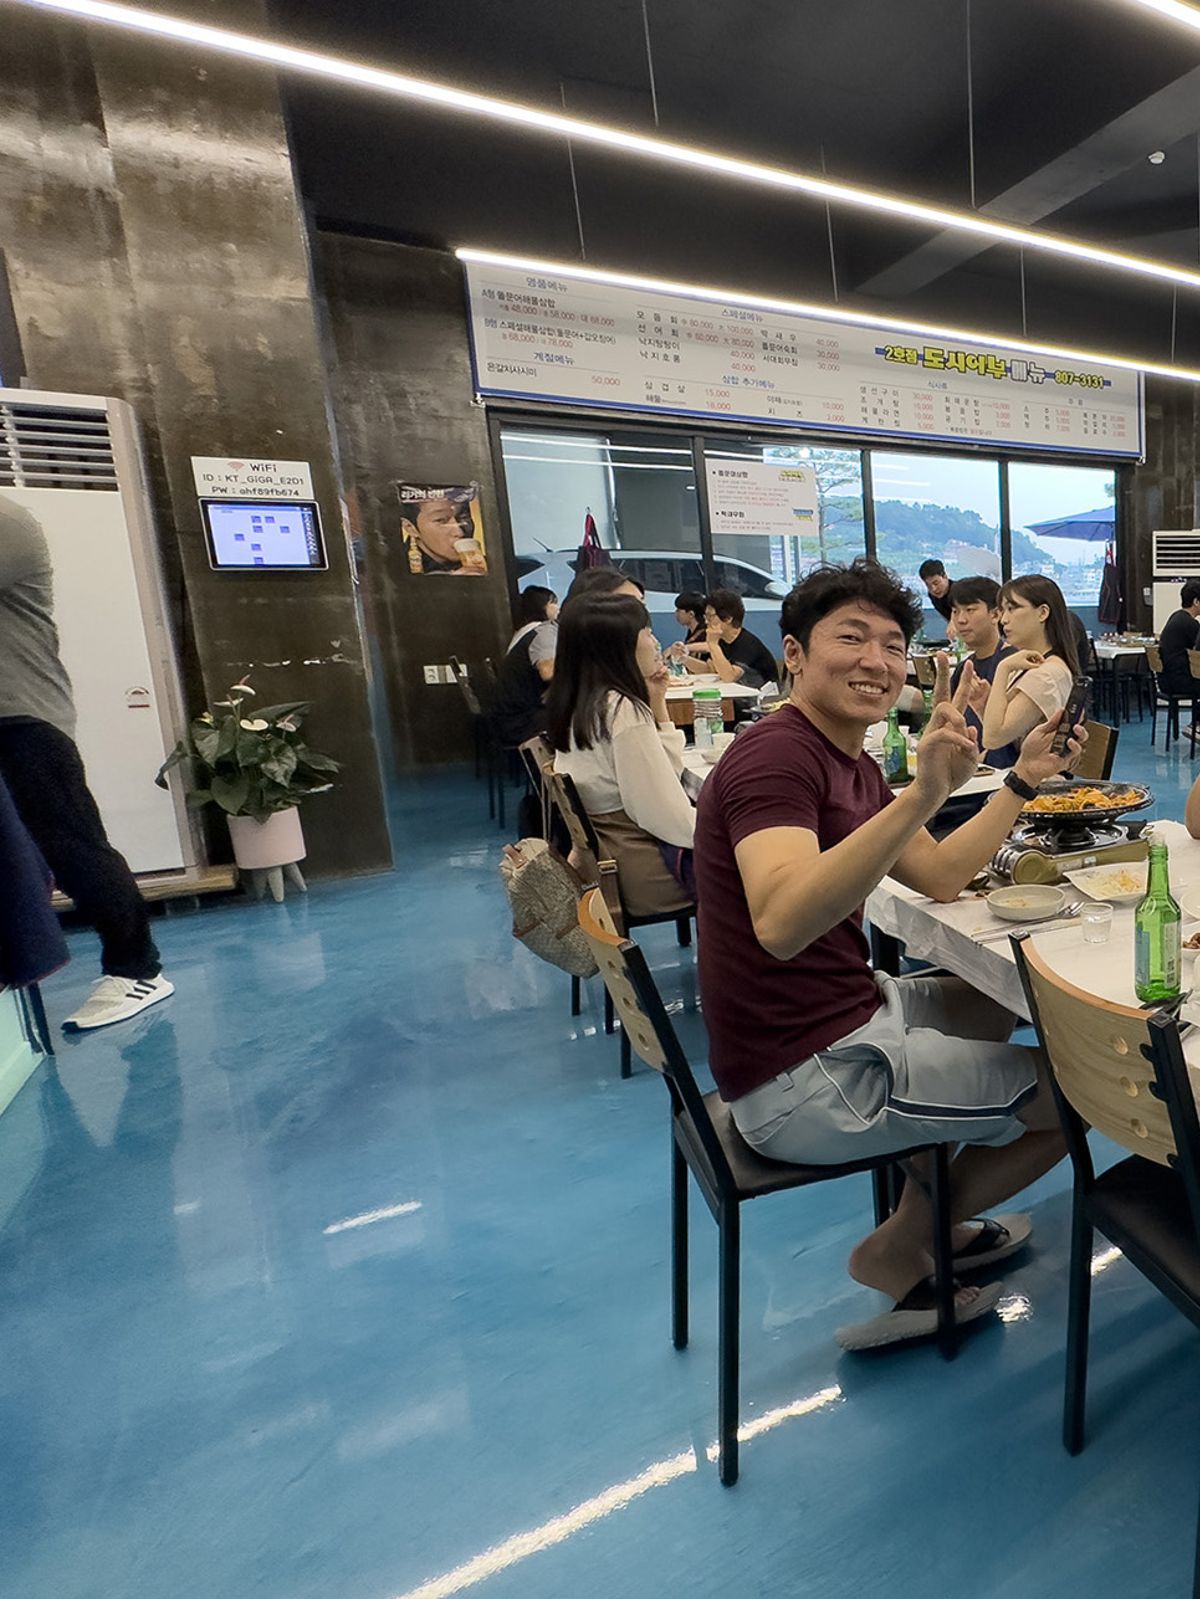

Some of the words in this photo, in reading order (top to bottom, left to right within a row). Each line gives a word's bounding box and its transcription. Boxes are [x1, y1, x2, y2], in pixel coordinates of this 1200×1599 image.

[1054, 369, 1104, 389] 807-3131
[250, 463, 277, 473] WiFi
[203, 474, 214, 482] ID
